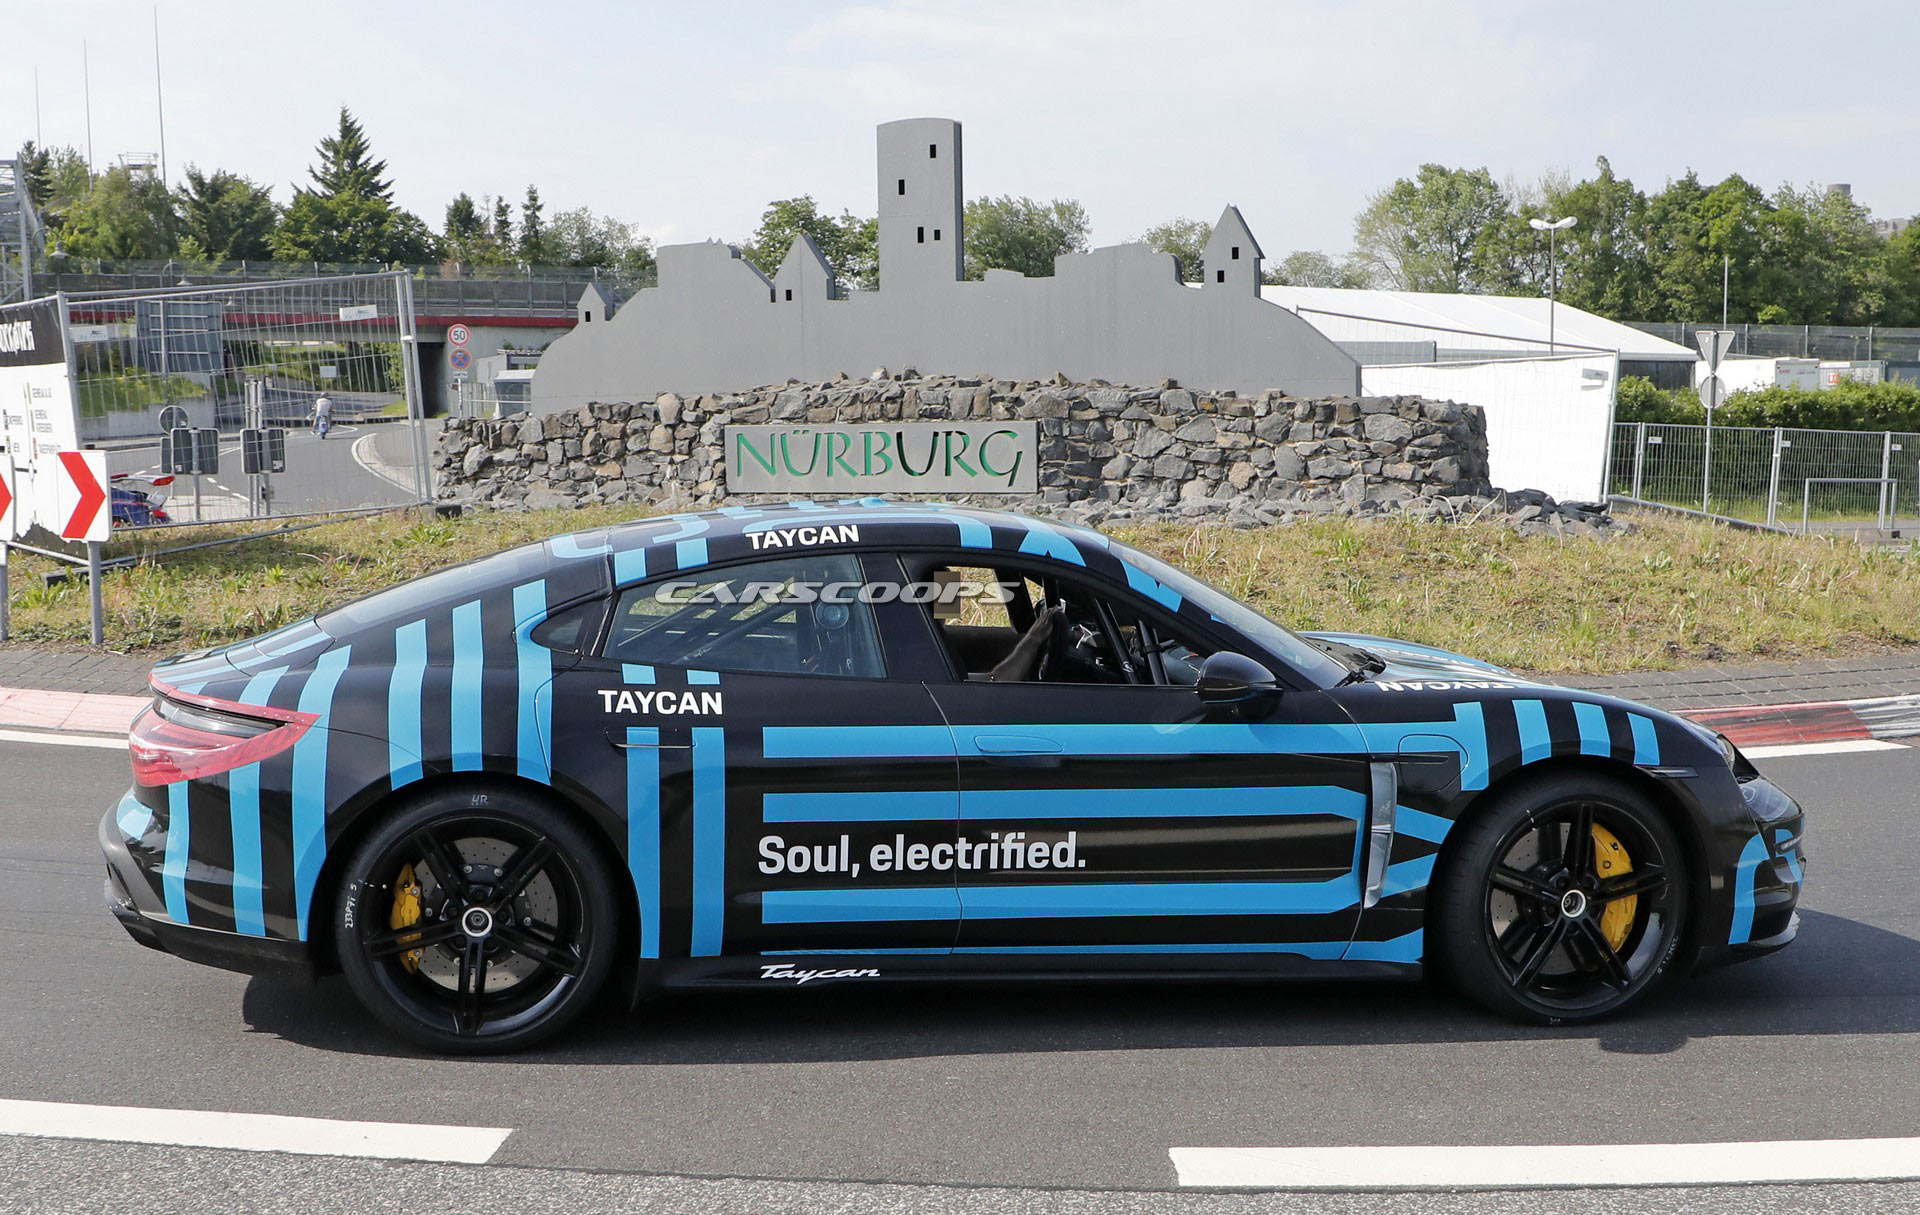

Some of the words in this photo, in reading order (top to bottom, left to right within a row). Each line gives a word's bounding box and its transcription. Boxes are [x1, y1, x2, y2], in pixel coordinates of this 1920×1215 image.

[453, 330, 465, 341] 50
[736, 430, 1023, 487] NÜRBURG
[745, 524, 860, 550] TAYCAN
[597, 689, 724, 716] TAYCAN
[758, 834, 860, 878] Soul,
[869, 831, 1087, 872] electrified.
[760, 963, 881, 985] Taycan
